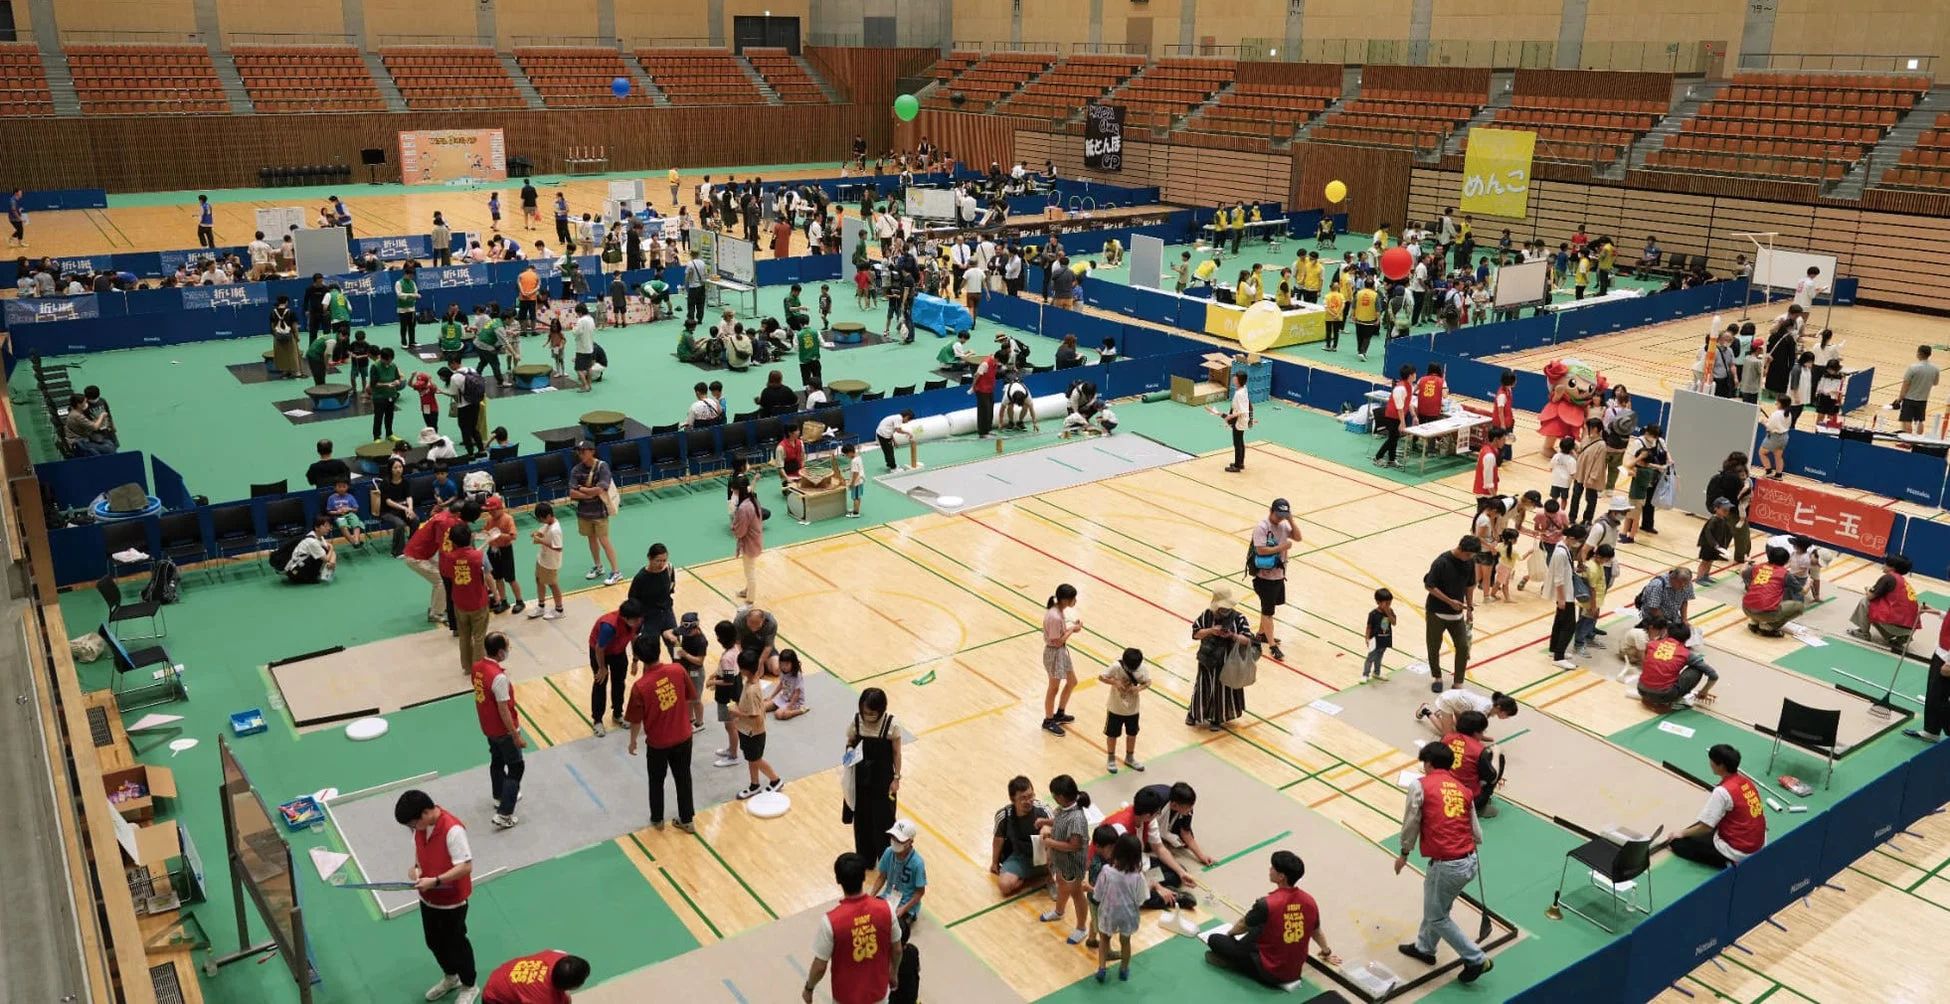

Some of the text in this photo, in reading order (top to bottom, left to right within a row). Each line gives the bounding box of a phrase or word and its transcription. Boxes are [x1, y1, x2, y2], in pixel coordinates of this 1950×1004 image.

[1464, 170, 1526, 197] めんこ
[1794, 501, 1862, 540] ビー玉
[1860, 533, 1887, 550] GP
